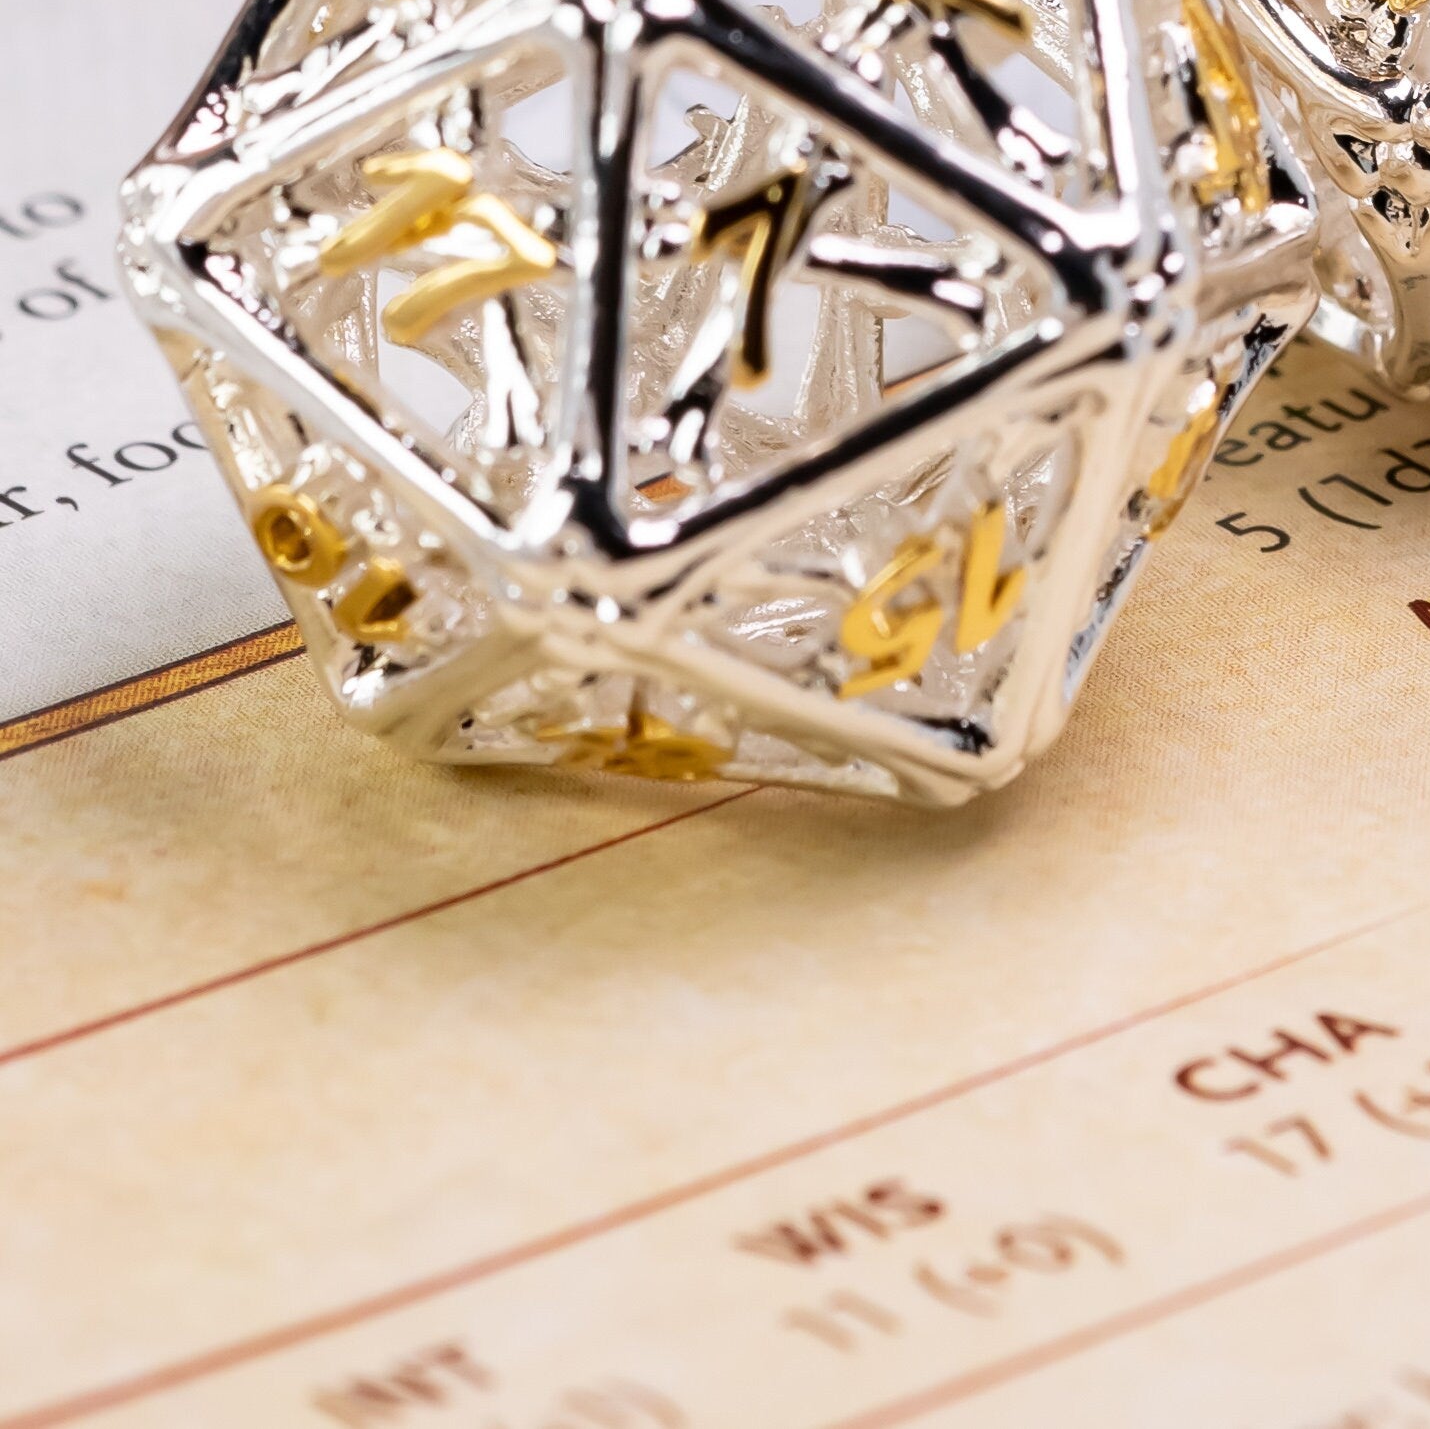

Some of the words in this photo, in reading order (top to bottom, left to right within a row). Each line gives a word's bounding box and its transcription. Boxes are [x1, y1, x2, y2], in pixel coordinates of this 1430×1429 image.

[18, 258, 116, 320] of
[1212, 387, 1390, 467] eatu
[1215, 512, 1291, 554] 5
[1173, 1010, 1402, 1103] CHA
[1223, 1115, 1333, 1177] 17
[730, 1176, 947, 1269] WIS
